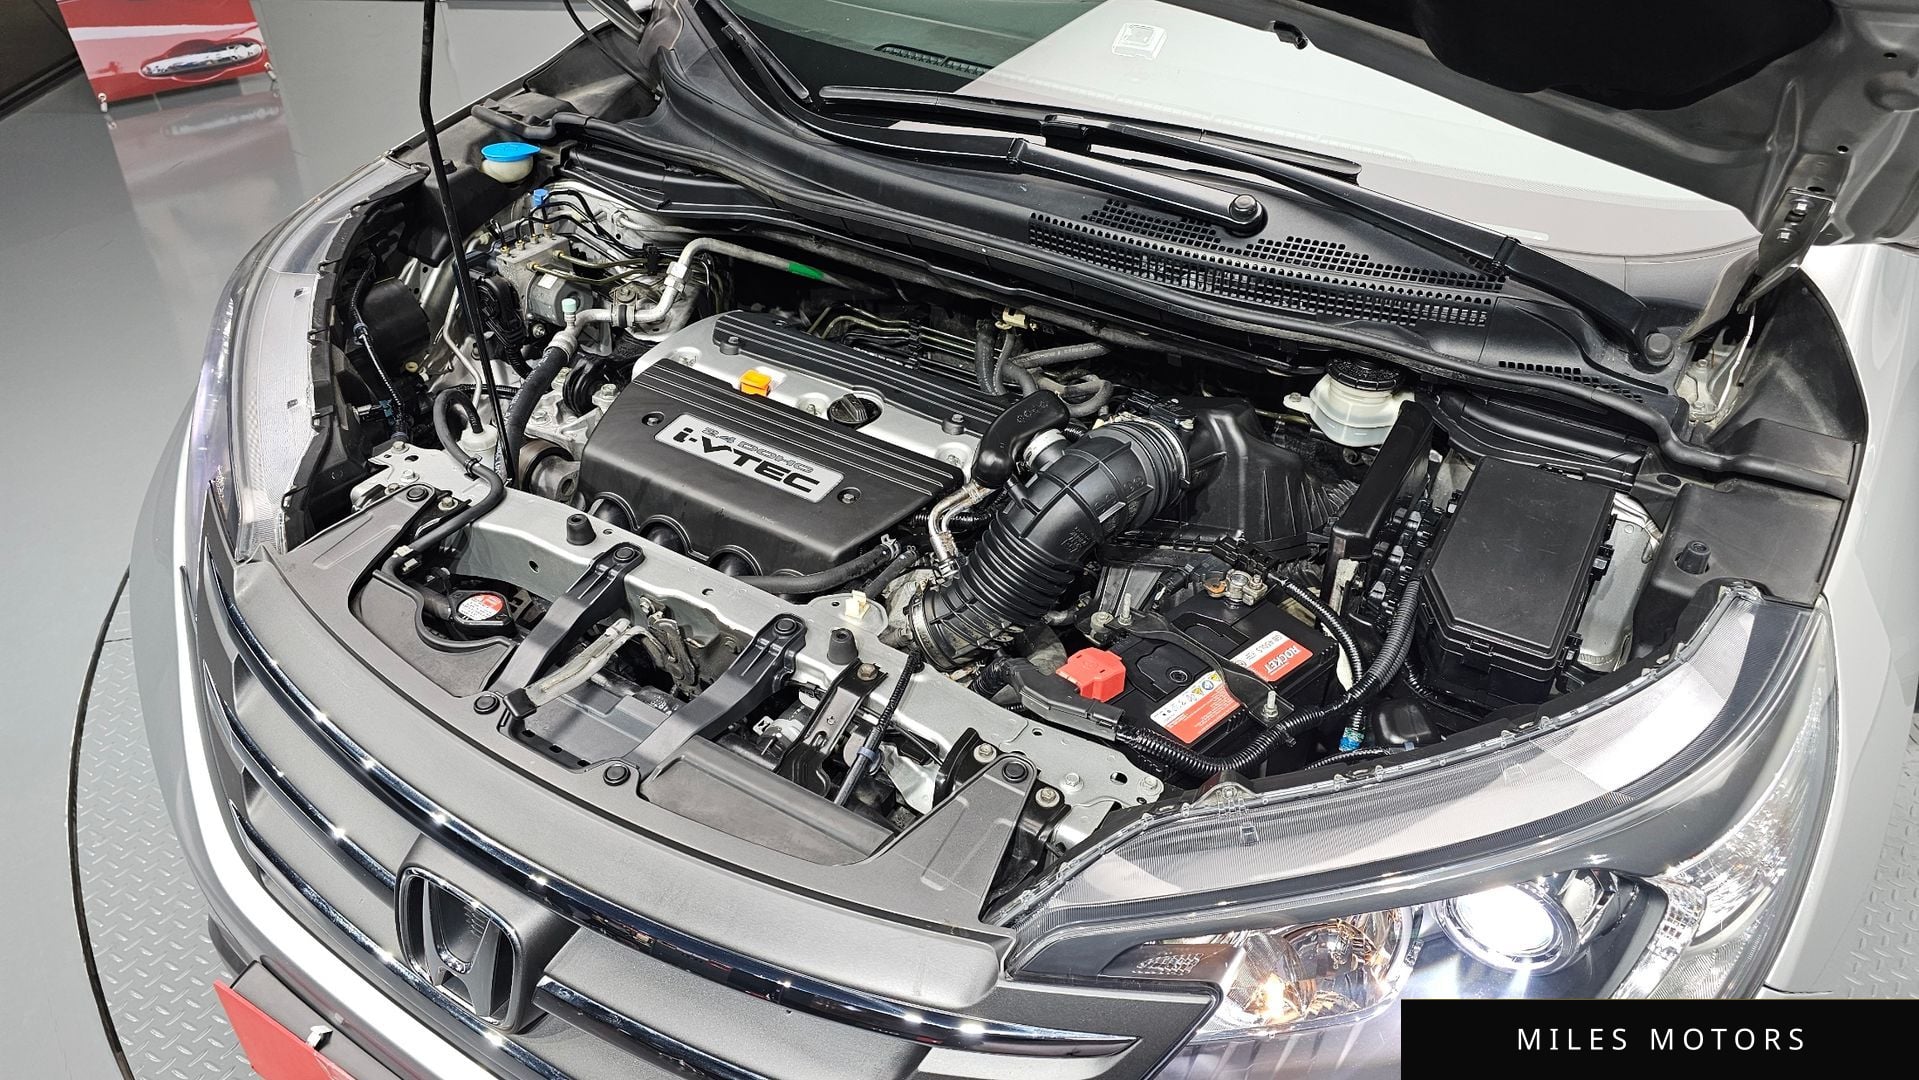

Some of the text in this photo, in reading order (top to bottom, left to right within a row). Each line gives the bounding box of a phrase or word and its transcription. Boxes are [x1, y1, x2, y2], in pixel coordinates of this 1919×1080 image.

[673, 427, 820, 493] i-VTEC
[737, 440, 814, 474] DOHC
[1264, 645, 1301, 674] ROCKET
